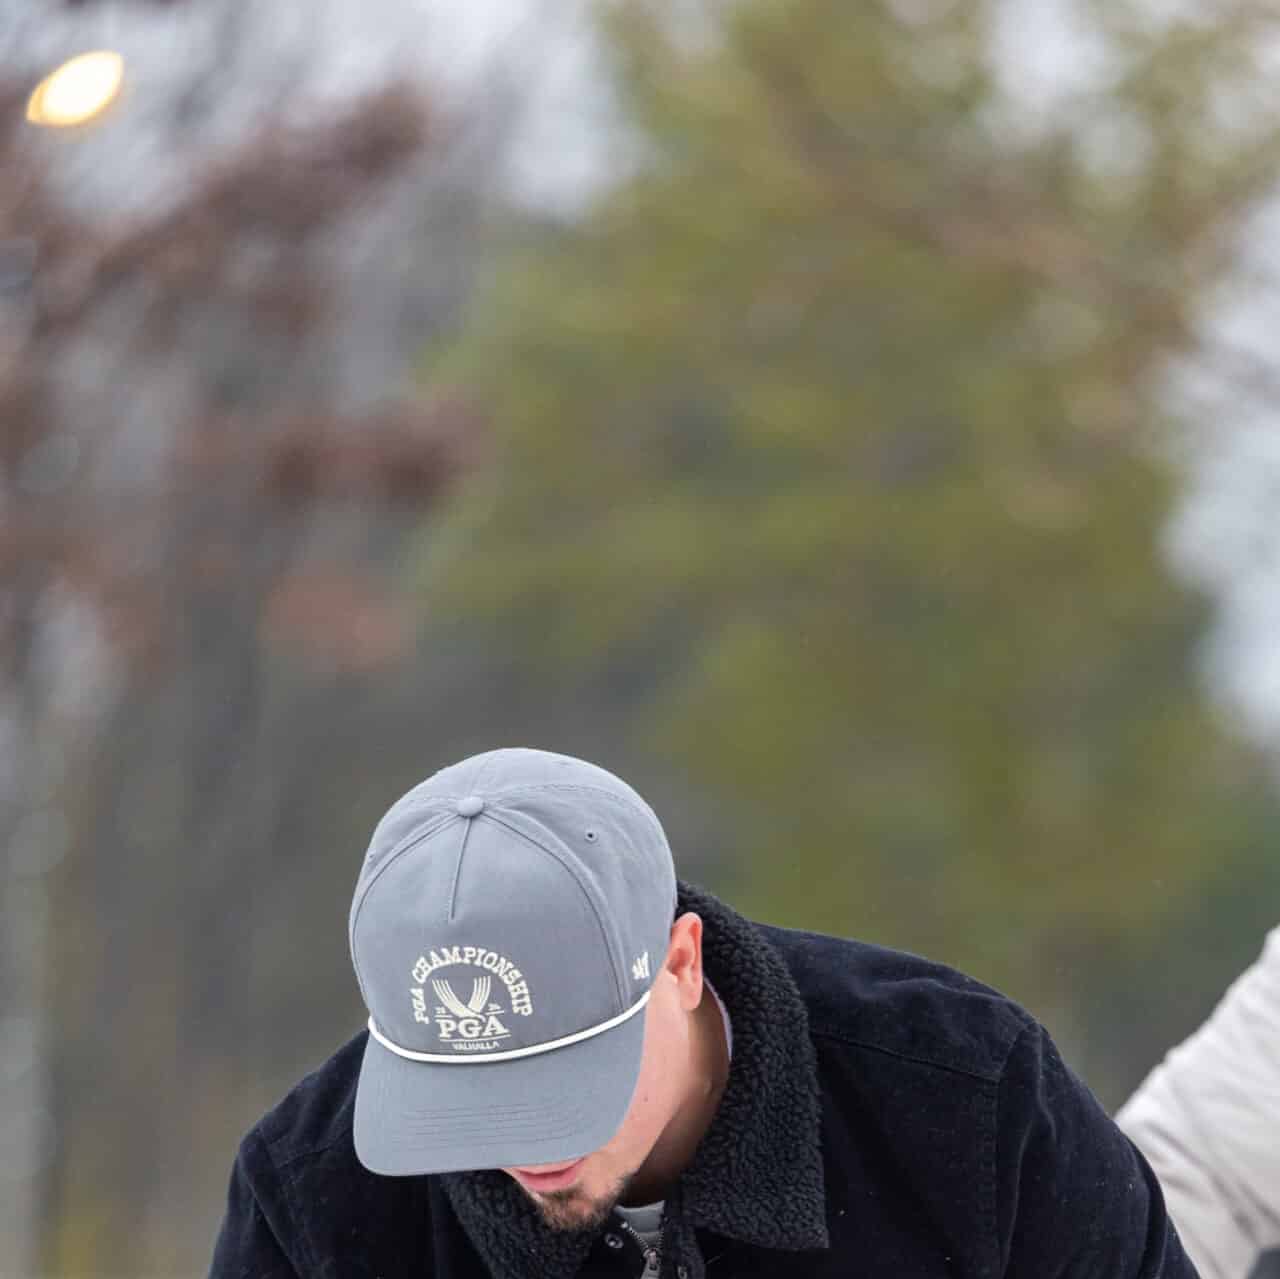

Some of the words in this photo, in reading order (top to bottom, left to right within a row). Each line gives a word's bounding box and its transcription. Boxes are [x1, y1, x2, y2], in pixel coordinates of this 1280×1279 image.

[411, 946, 533, 1016] CHAMPIONSHIP
[410, 988, 430, 1024] PGA
[435, 1016, 510, 1038] PGA
